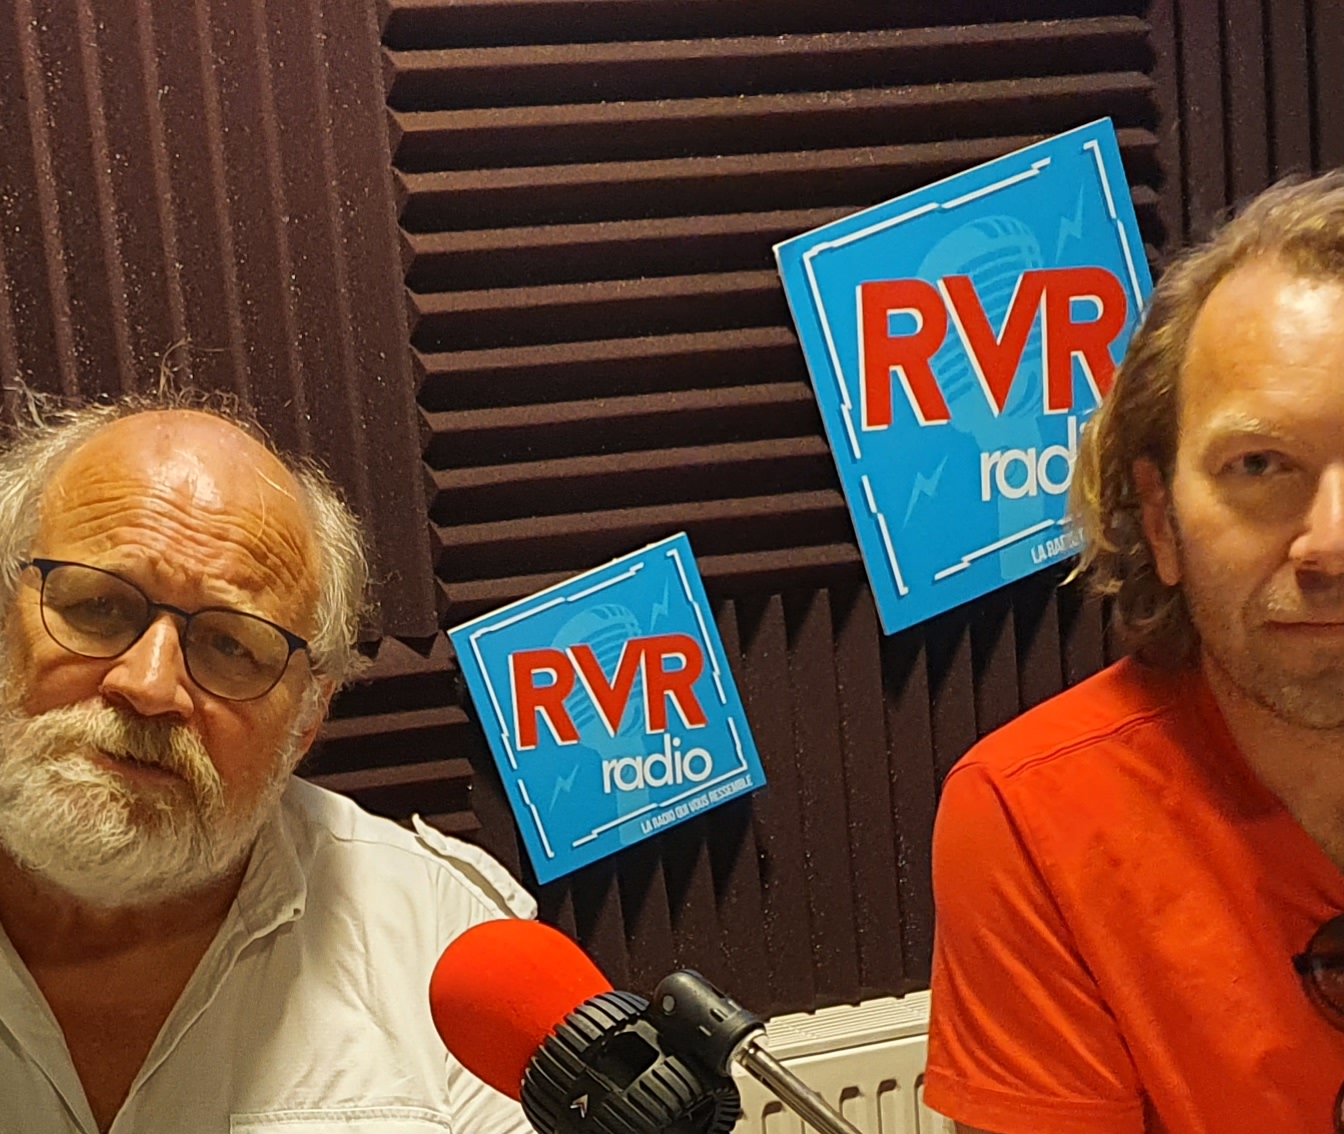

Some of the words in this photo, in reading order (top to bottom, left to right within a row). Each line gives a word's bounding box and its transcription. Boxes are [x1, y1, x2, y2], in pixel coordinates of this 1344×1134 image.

[855, 265, 1128, 431] RVR
[980, 415, 1086, 502] rad
[508, 633, 709, 751] RVR
[602, 733, 713, 794] radio
